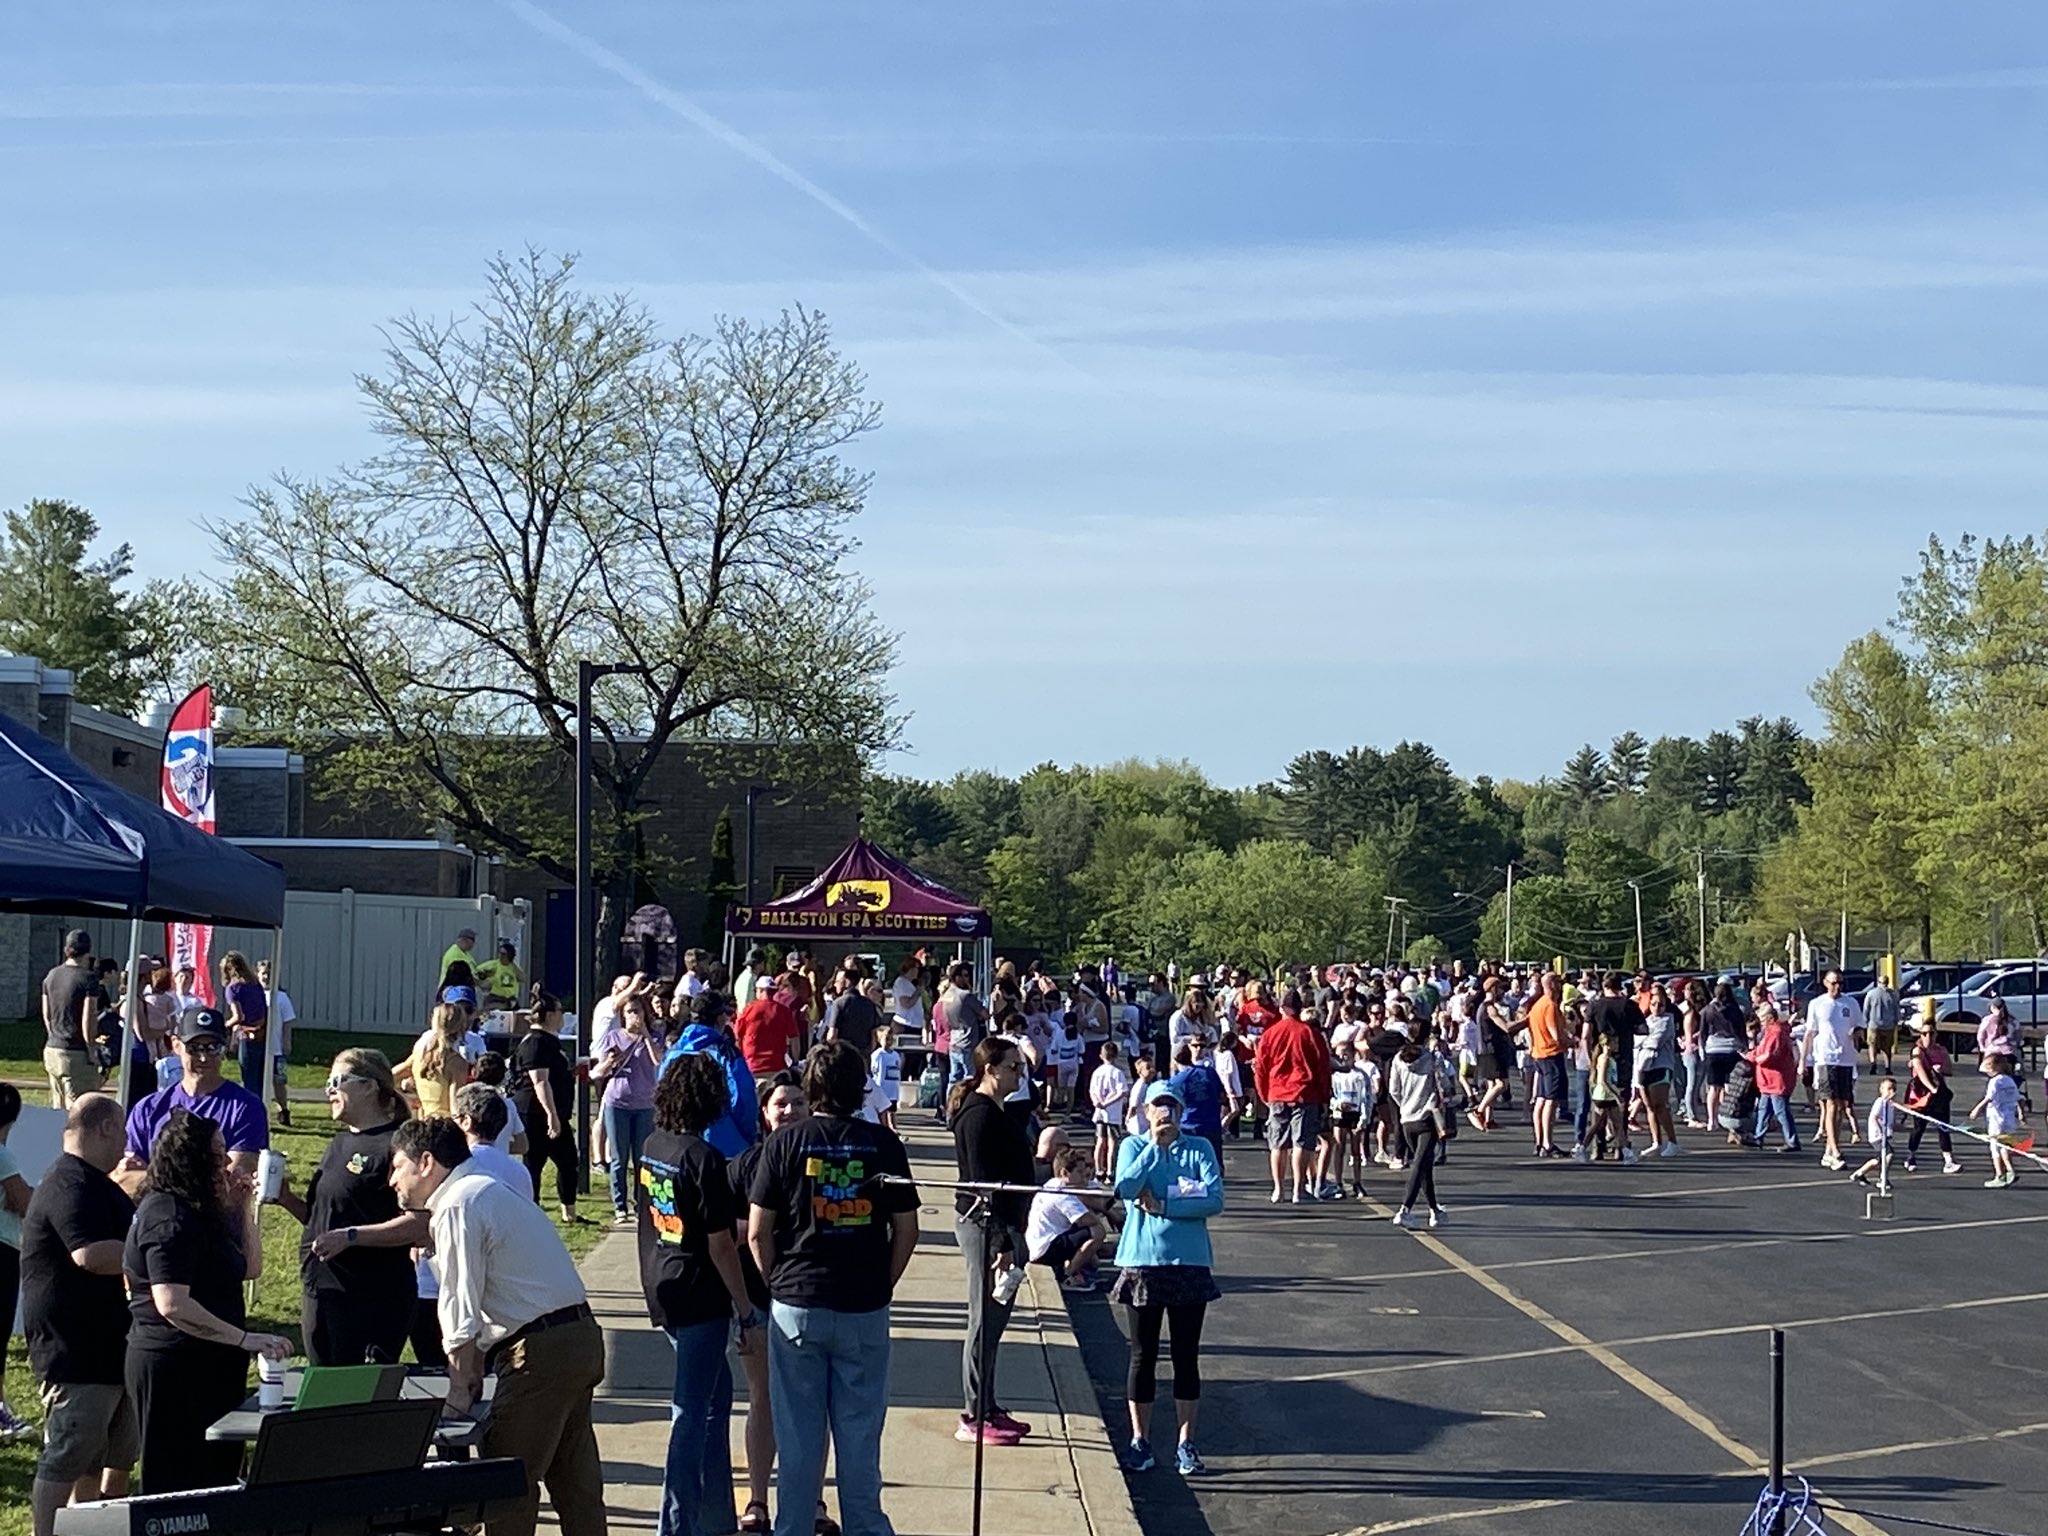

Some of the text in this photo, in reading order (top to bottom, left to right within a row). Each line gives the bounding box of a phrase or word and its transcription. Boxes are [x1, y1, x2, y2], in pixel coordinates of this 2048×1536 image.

[760, 911, 948, 929] BALLSTON SPA SCOTTIES
[160, 1512, 209, 1535] YAMAHA
